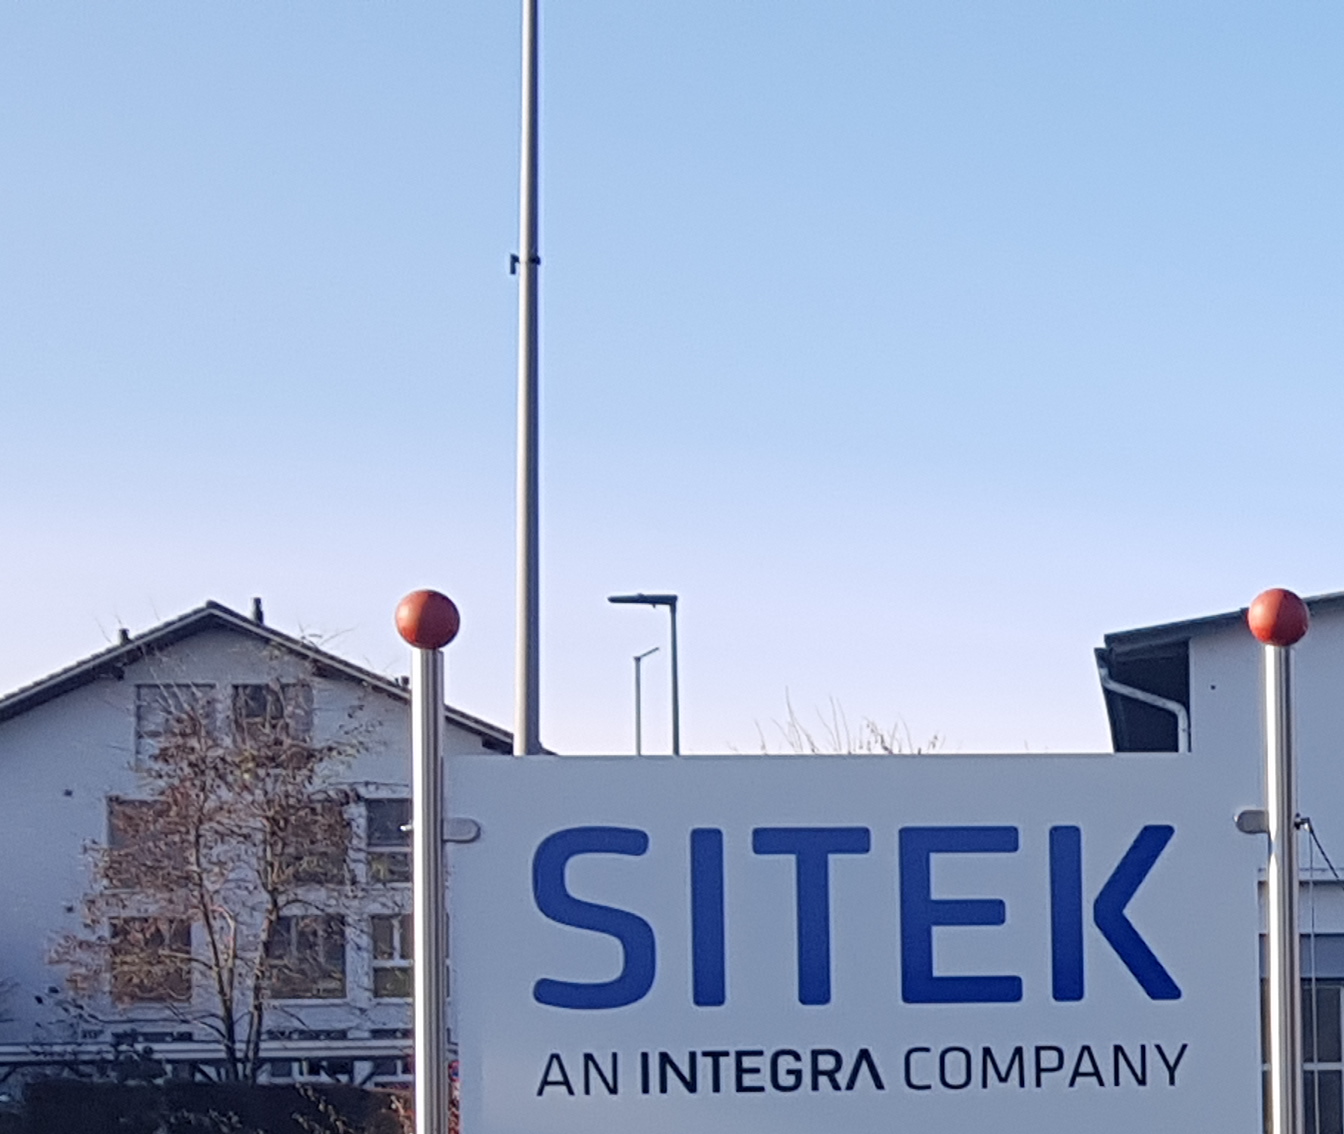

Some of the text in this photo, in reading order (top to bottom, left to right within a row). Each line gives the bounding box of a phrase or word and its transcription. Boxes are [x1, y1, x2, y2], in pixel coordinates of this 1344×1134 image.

[532, 825, 1182, 1010] SITEK
[537, 1043, 1188, 1096] AN INTEGRA COMPANY
